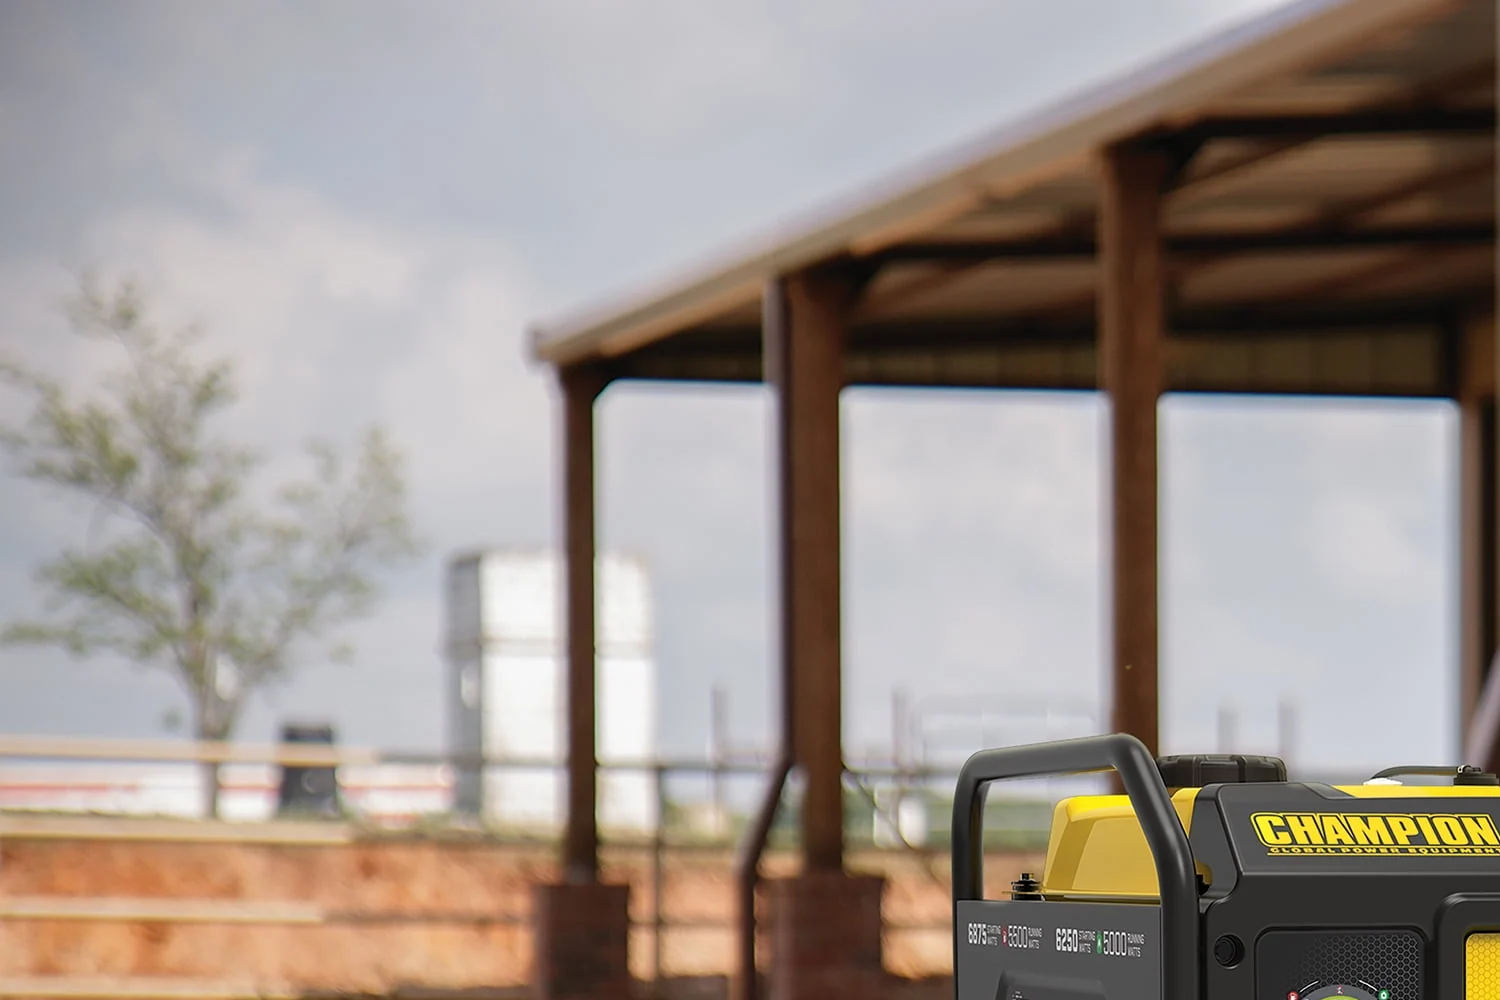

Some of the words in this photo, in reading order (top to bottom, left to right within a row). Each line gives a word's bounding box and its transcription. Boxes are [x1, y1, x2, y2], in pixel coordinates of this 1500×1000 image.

[968, 922, 987, 945] 6875
[1055, 927, 1078, 953] 6250
[1103, 930, 1127, 956] 5000
